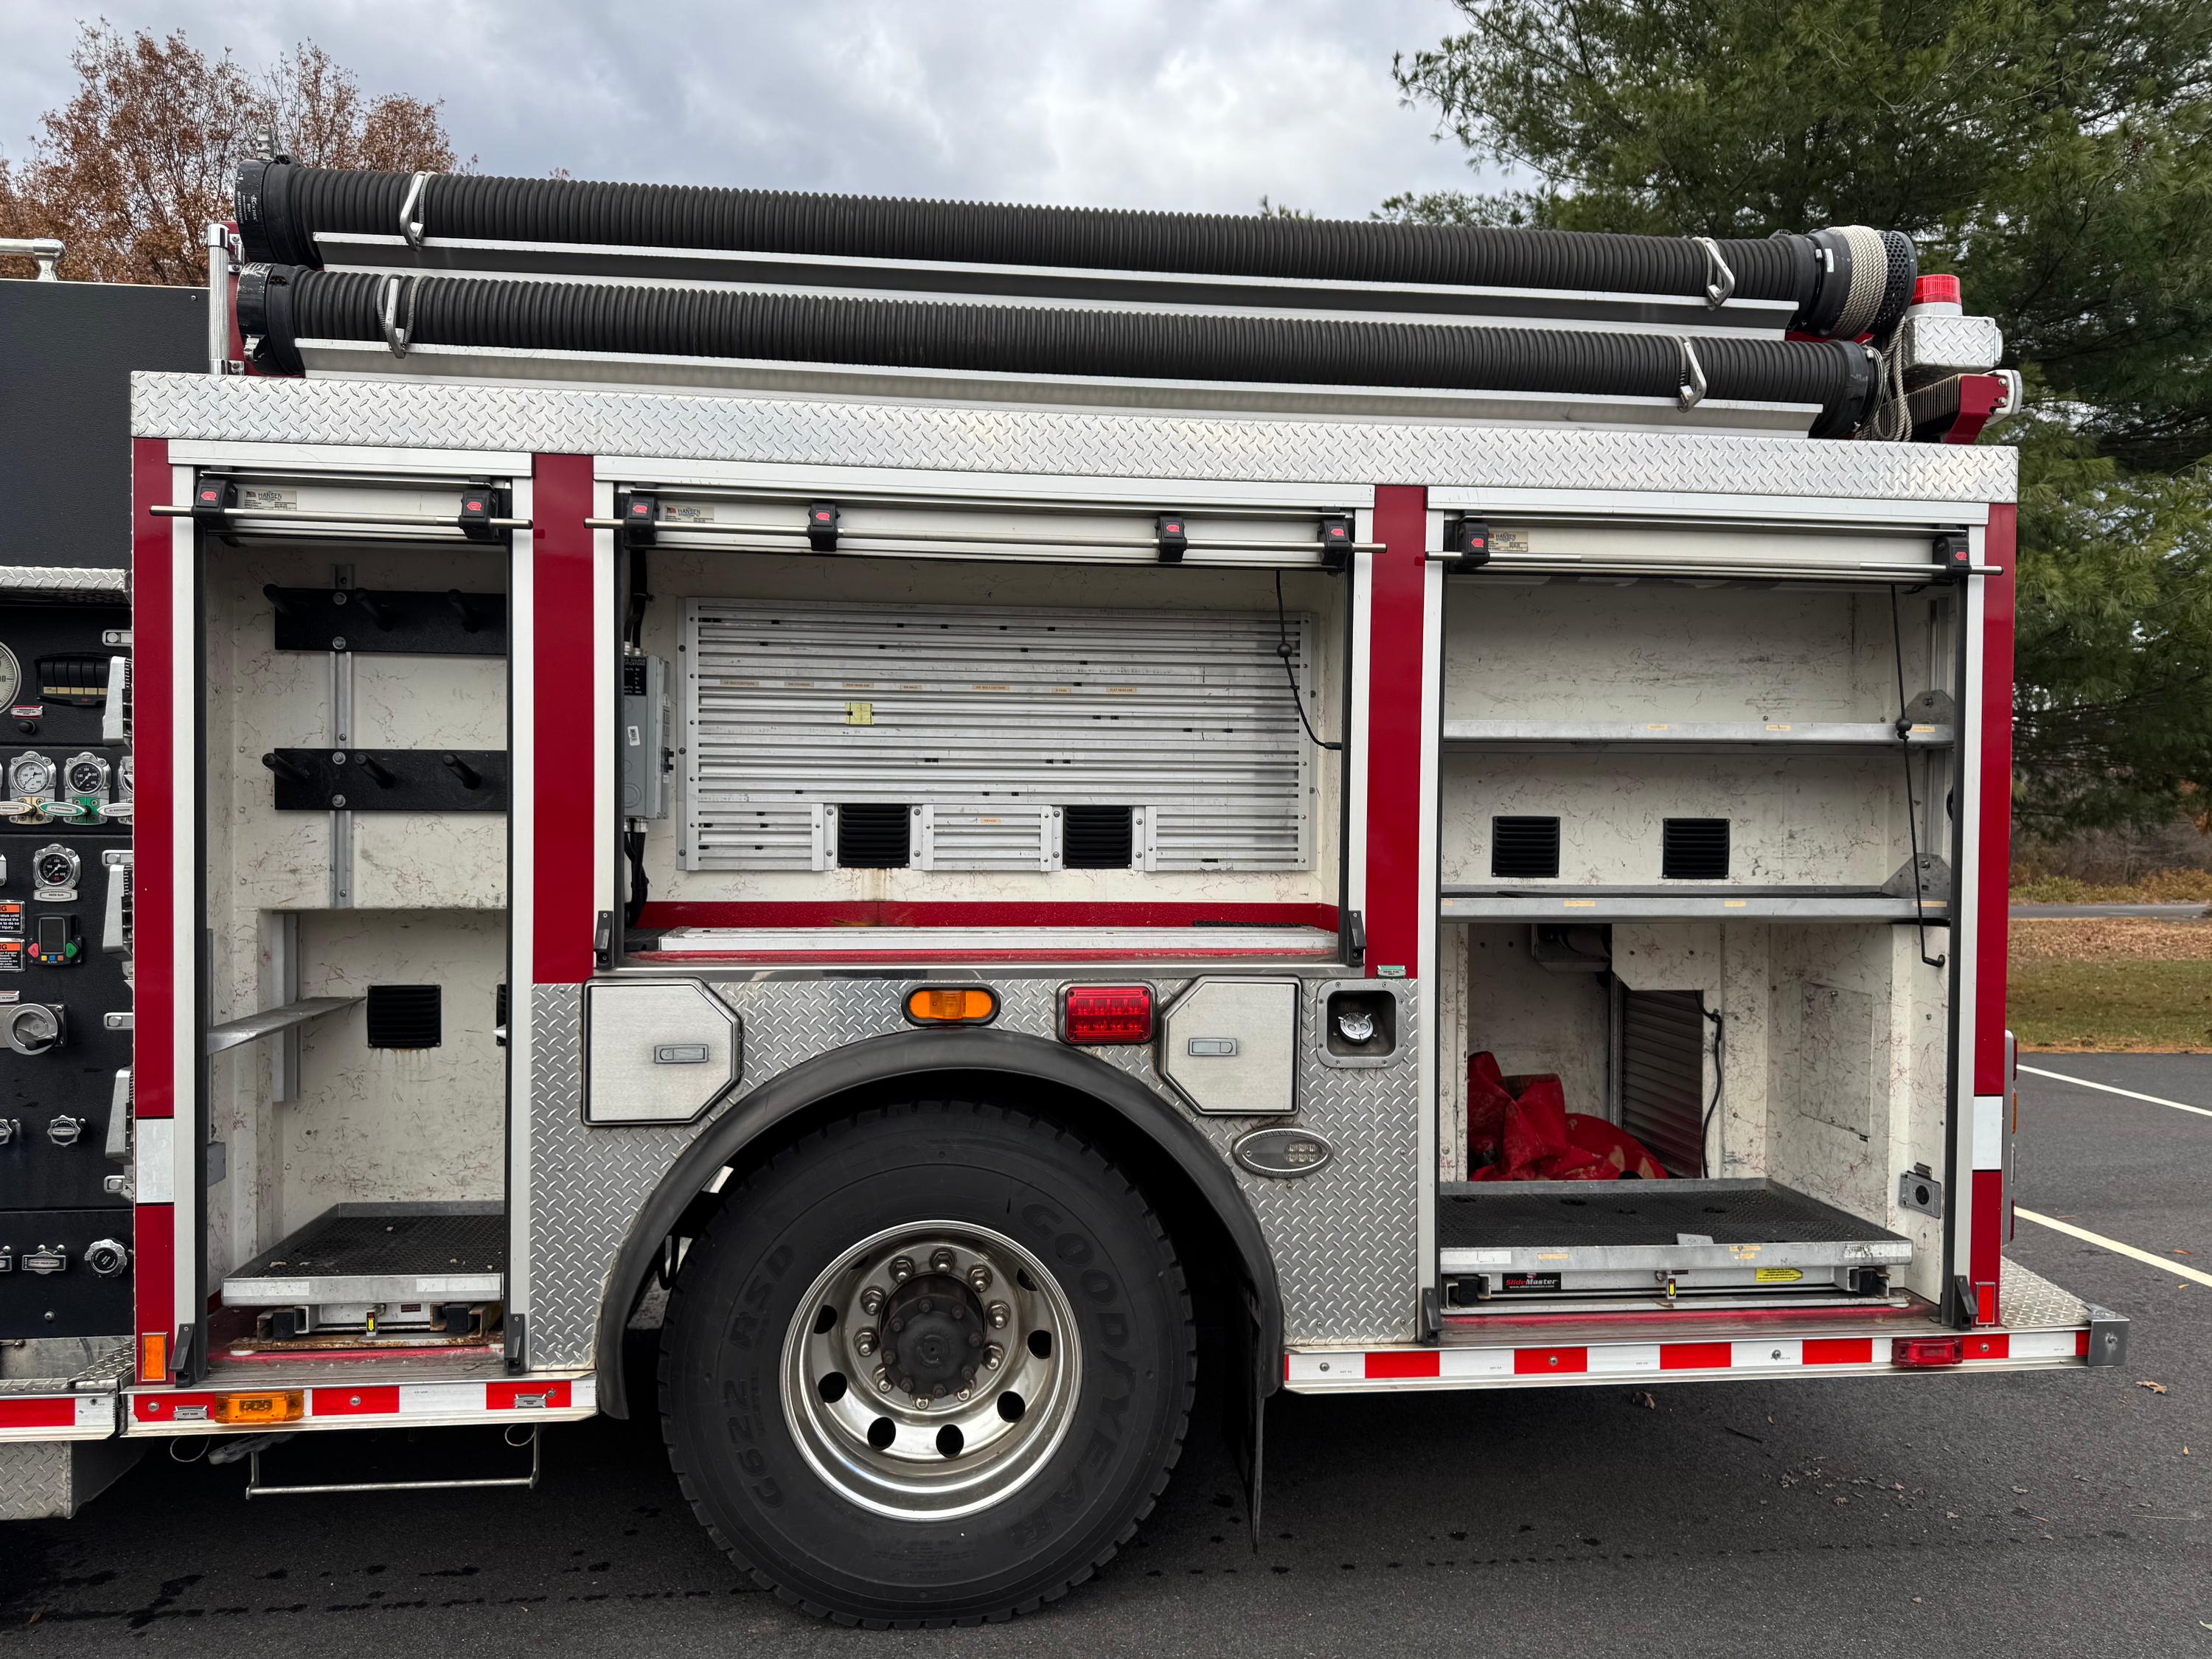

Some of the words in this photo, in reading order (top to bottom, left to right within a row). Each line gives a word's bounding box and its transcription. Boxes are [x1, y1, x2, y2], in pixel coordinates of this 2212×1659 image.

[258, 492, 282, 501] HANSEN
[727, 1244, 796, 1352] RSD
[1506, 1278, 1557, 1286] SlideMaster
[1009, 1203, 1136, 1548] GOODYEAR
[723, 1378, 785, 1509] G622
